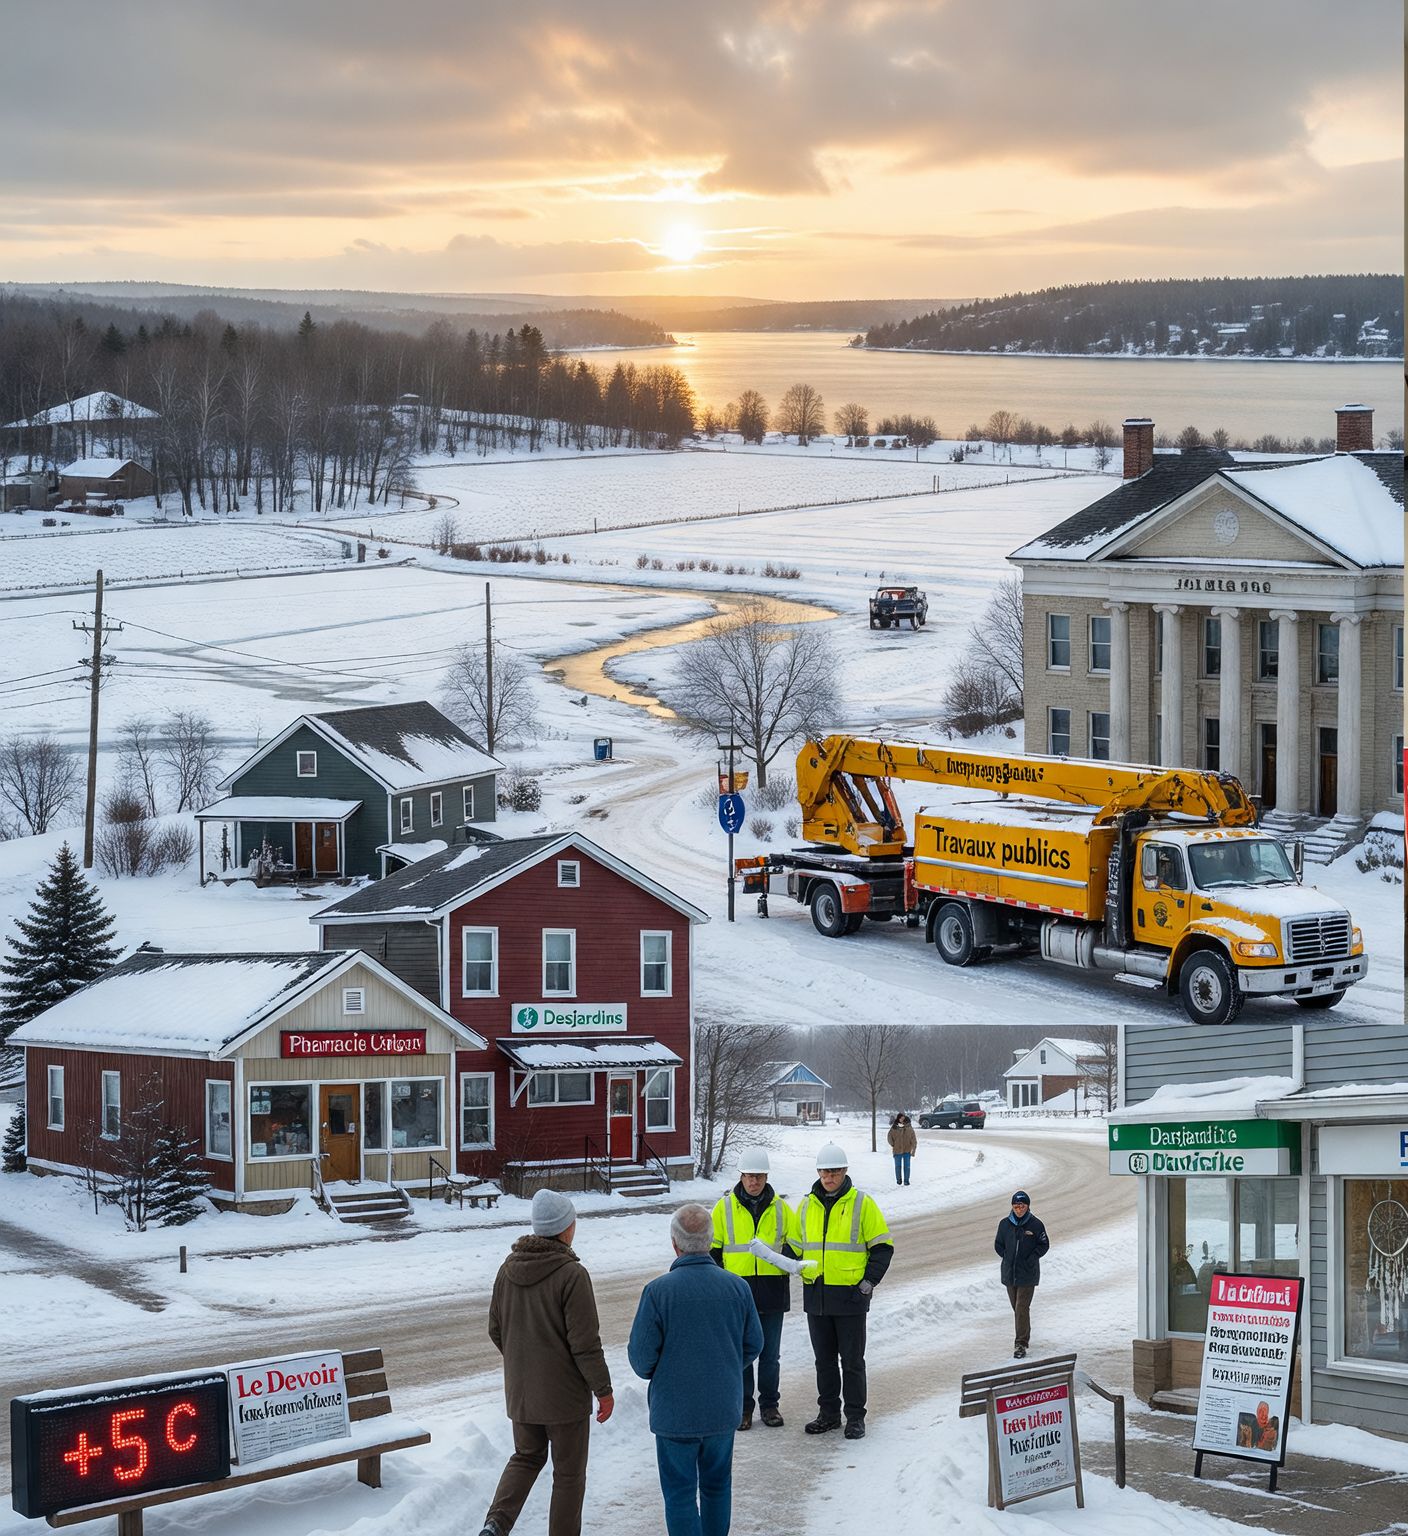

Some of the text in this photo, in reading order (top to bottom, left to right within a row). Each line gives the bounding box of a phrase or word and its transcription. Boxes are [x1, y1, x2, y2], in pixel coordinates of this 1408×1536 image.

[933, 826, 1071, 870] Travaux publics
[544, 1009, 623, 1028] Desjardins
[236, 1363, 338, 1399] Le Devoir
[166, 1403, 197, 1452] C
